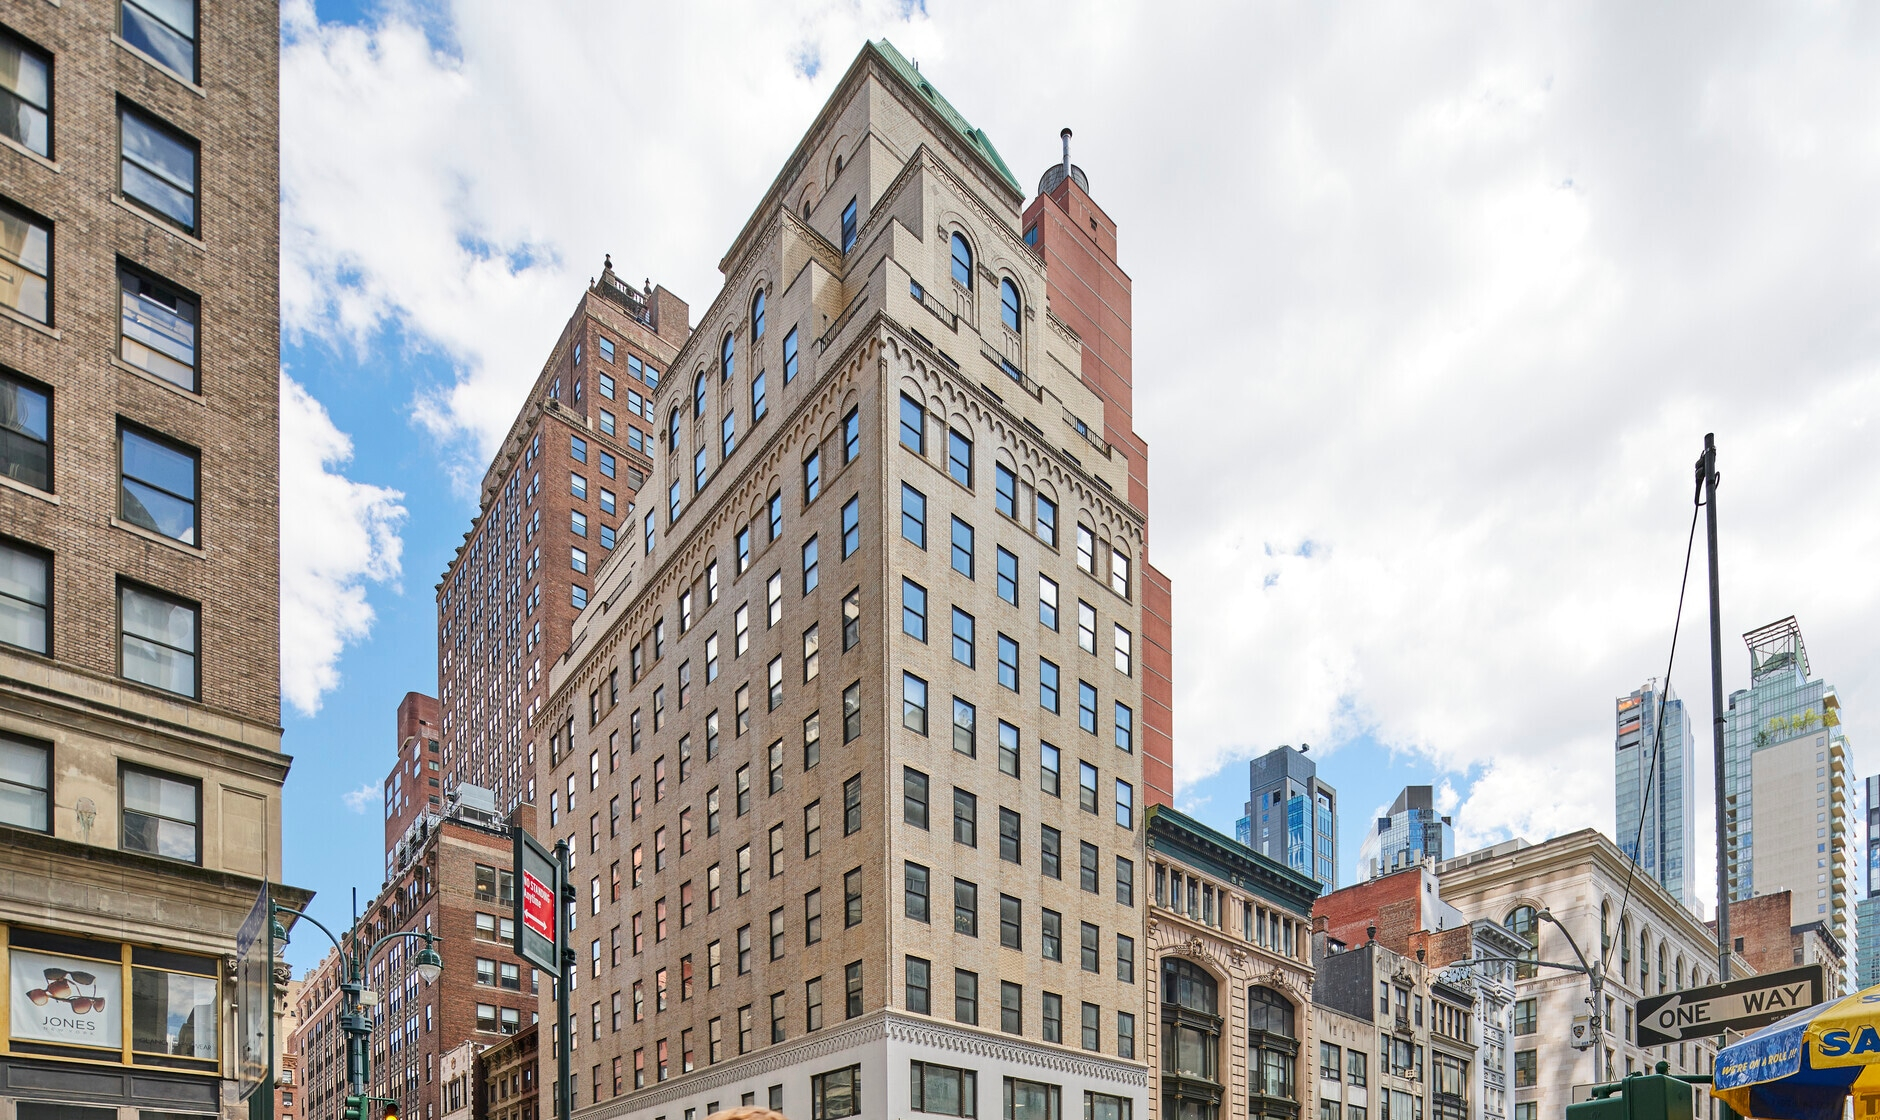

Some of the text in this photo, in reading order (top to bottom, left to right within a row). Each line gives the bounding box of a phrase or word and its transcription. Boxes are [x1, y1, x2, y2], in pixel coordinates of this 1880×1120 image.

[530, 881, 550, 903] STANDING
[1659, 984, 1804, 1029] ONE WAY
[43, 1016, 95, 1031] JONES
[1722, 1062, 1748, 1075] WE'RE
[1749, 1059, 1761, 1070] ON
[1762, 1056, 1767, 1066] A
